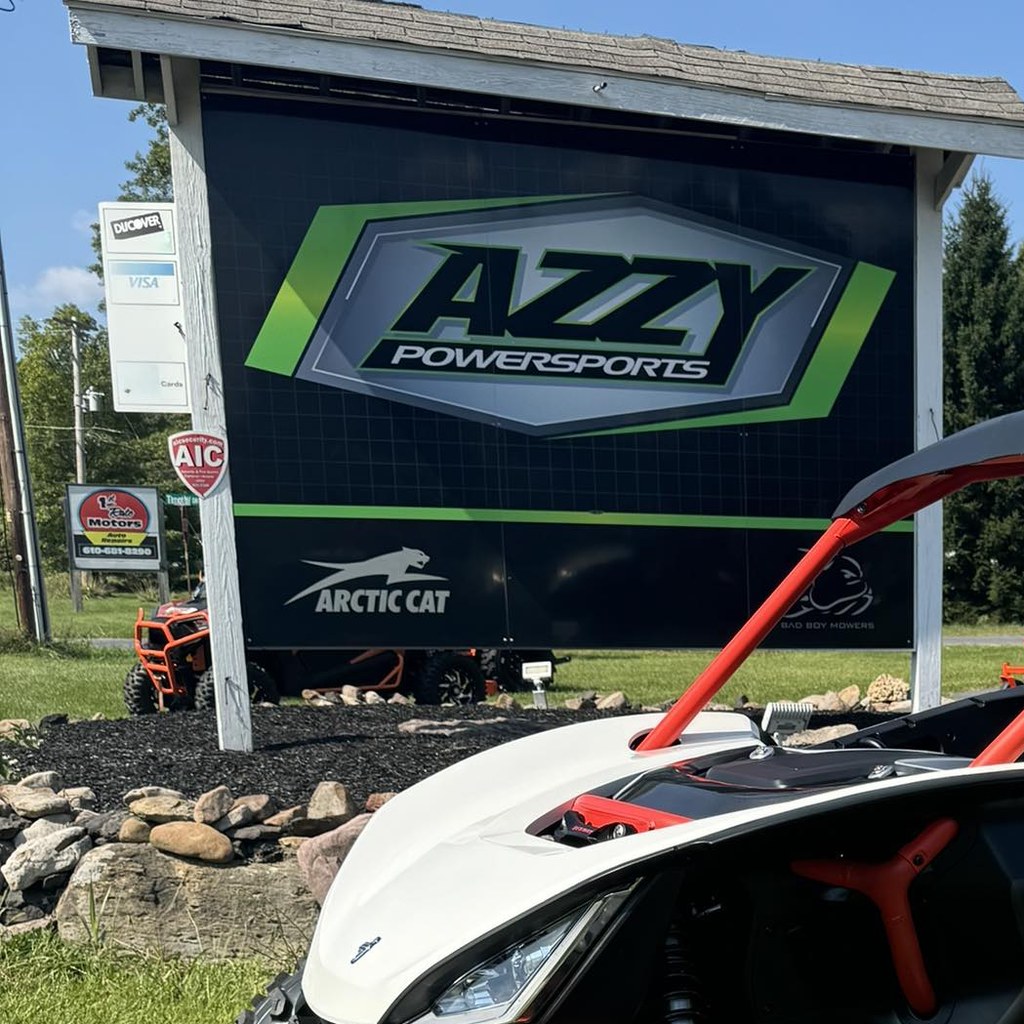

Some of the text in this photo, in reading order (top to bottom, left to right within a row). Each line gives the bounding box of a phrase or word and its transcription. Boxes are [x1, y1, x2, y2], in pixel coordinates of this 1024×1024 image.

[128, 276, 159, 288] VISA
[388, 241, 816, 380] AZZY
[391, 344, 710, 379] POWERSPORTS
[160, 380, 183, 388] Cards
[175, 444, 223, 467] AIC
[88, 519, 141, 528] Motors
[315, 588, 450, 613] ARCTIC CAT
[780, 621, 875, 630] BAD BOY MOWERS
